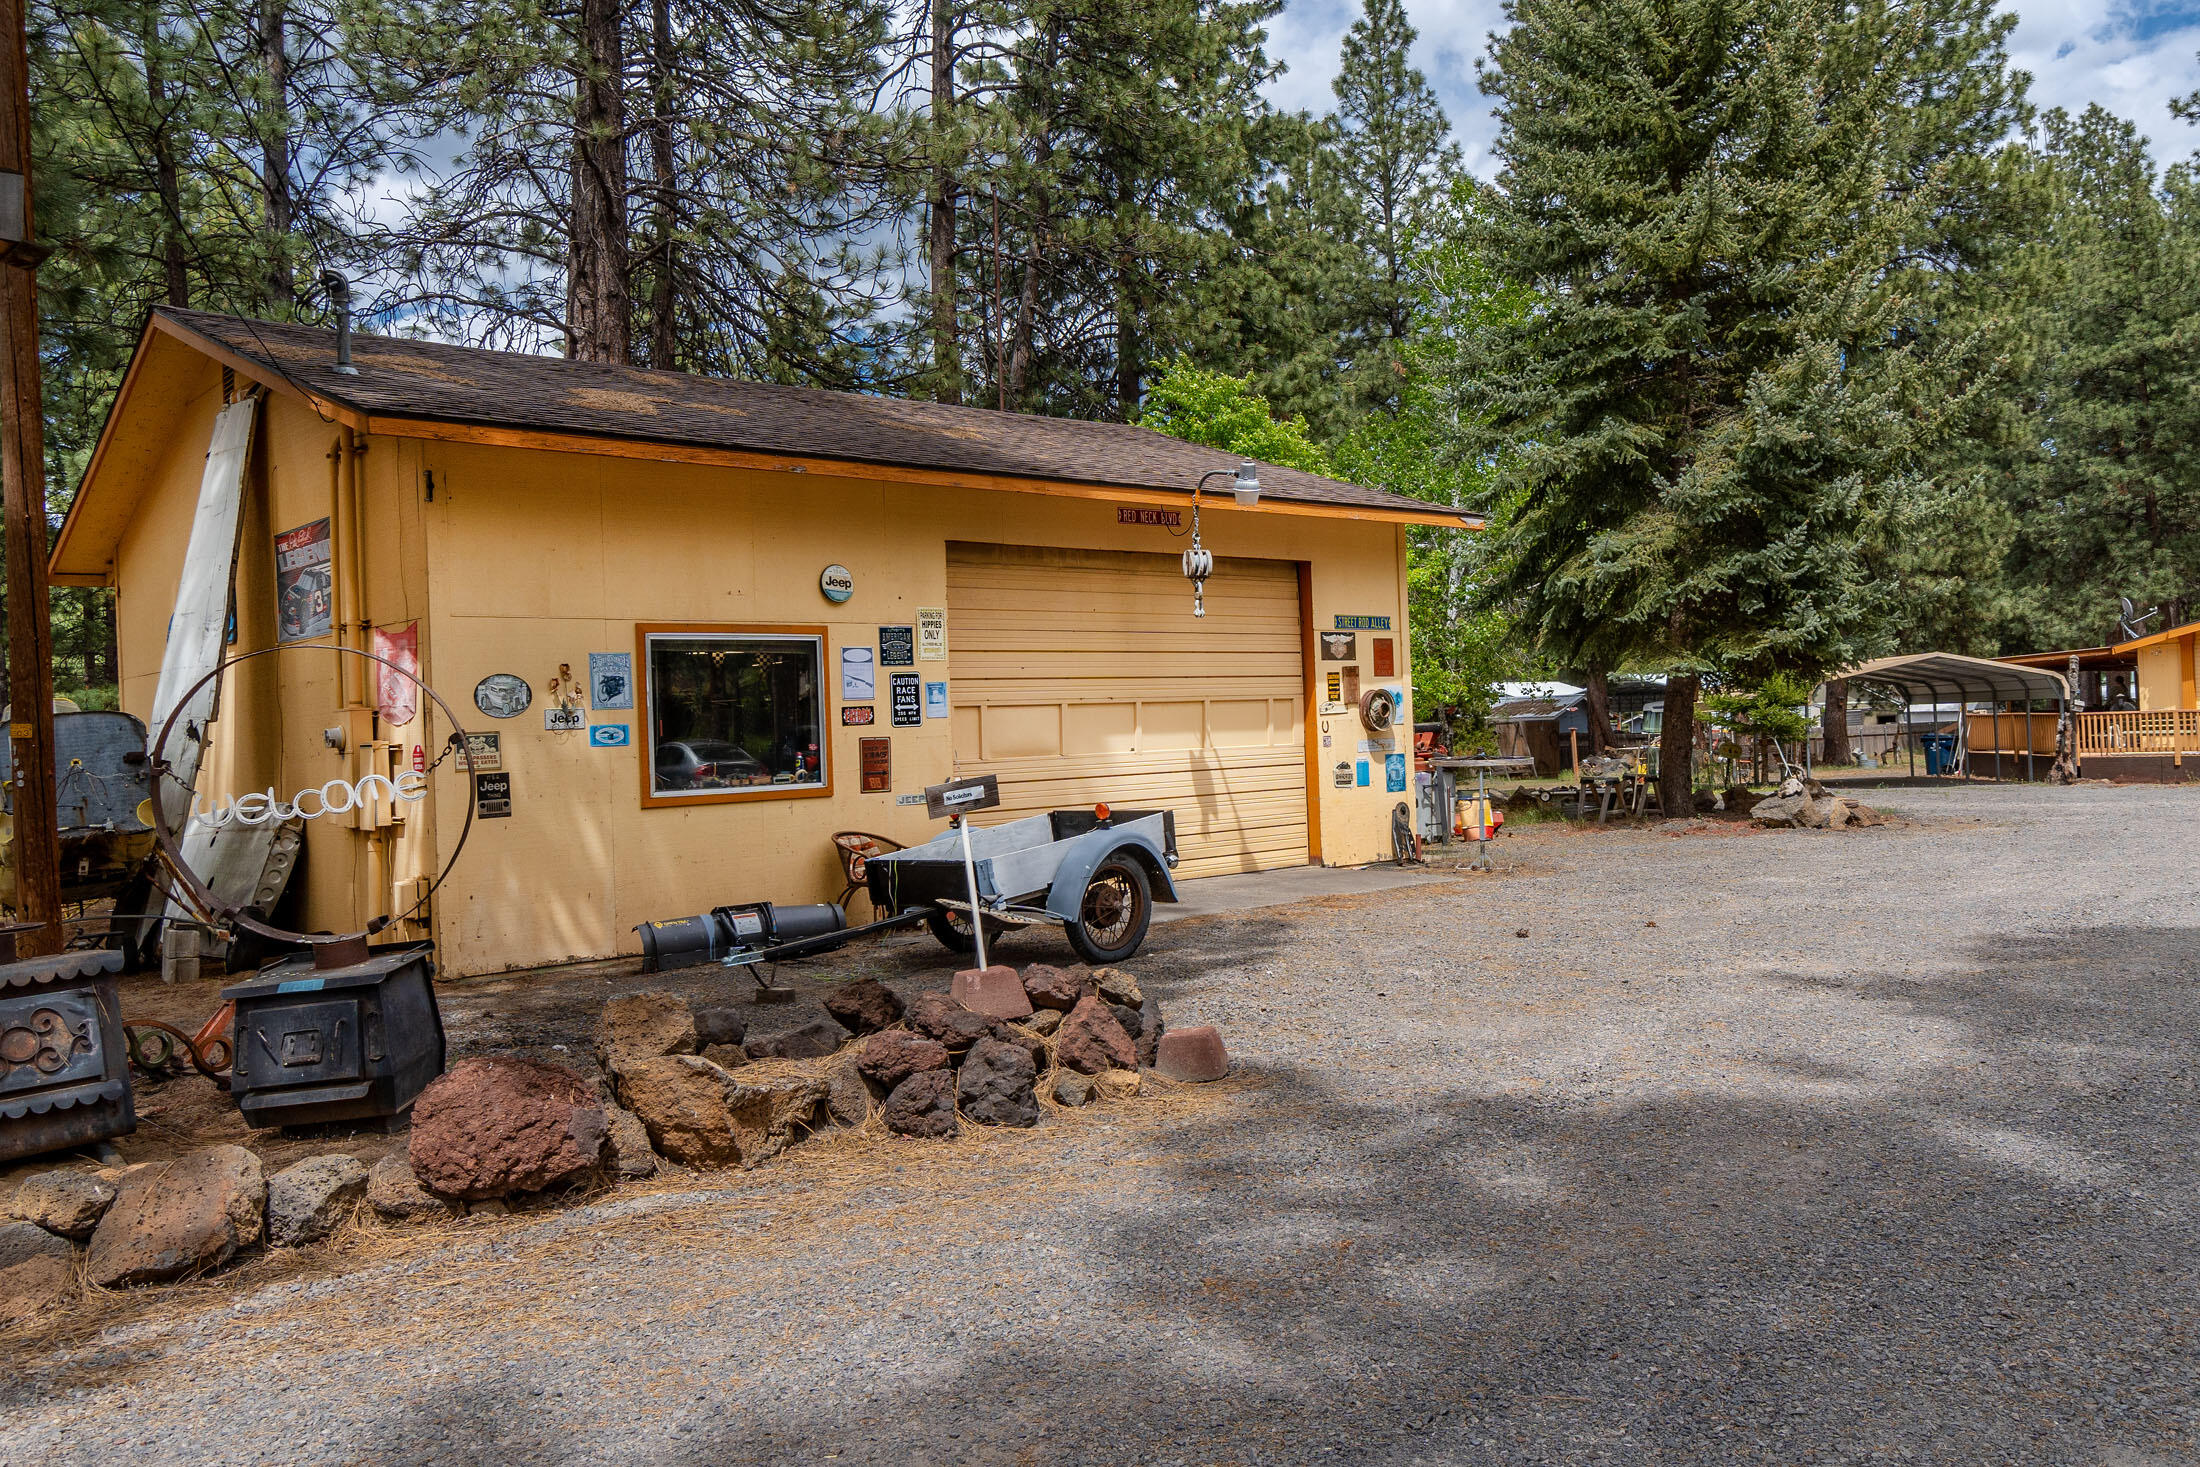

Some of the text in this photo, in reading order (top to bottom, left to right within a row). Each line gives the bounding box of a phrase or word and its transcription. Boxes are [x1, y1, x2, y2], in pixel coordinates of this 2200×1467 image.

[1123, 509, 1137, 522] RED
[1140, 511, 1158, 524] NECK
[277, 541, 289, 553] THE
[825, 576, 851, 590] Jeep
[314, 590, 324, 613] 3
[922, 620, 943, 629] HIPPIES
[1338, 616, 1388, 629] STREET ROD ALLEY
[882, 632, 912, 641] AMERICAN
[924, 630, 940, 640] ONLY
[886, 650, 908, 660] LEGEND
[892, 677, 919, 685] CAUTION
[896, 686, 916, 694] RACE
[897, 695, 916, 703] FANS
[480, 781, 507, 792] Jeep
[898, 795, 925, 804] JEEP
